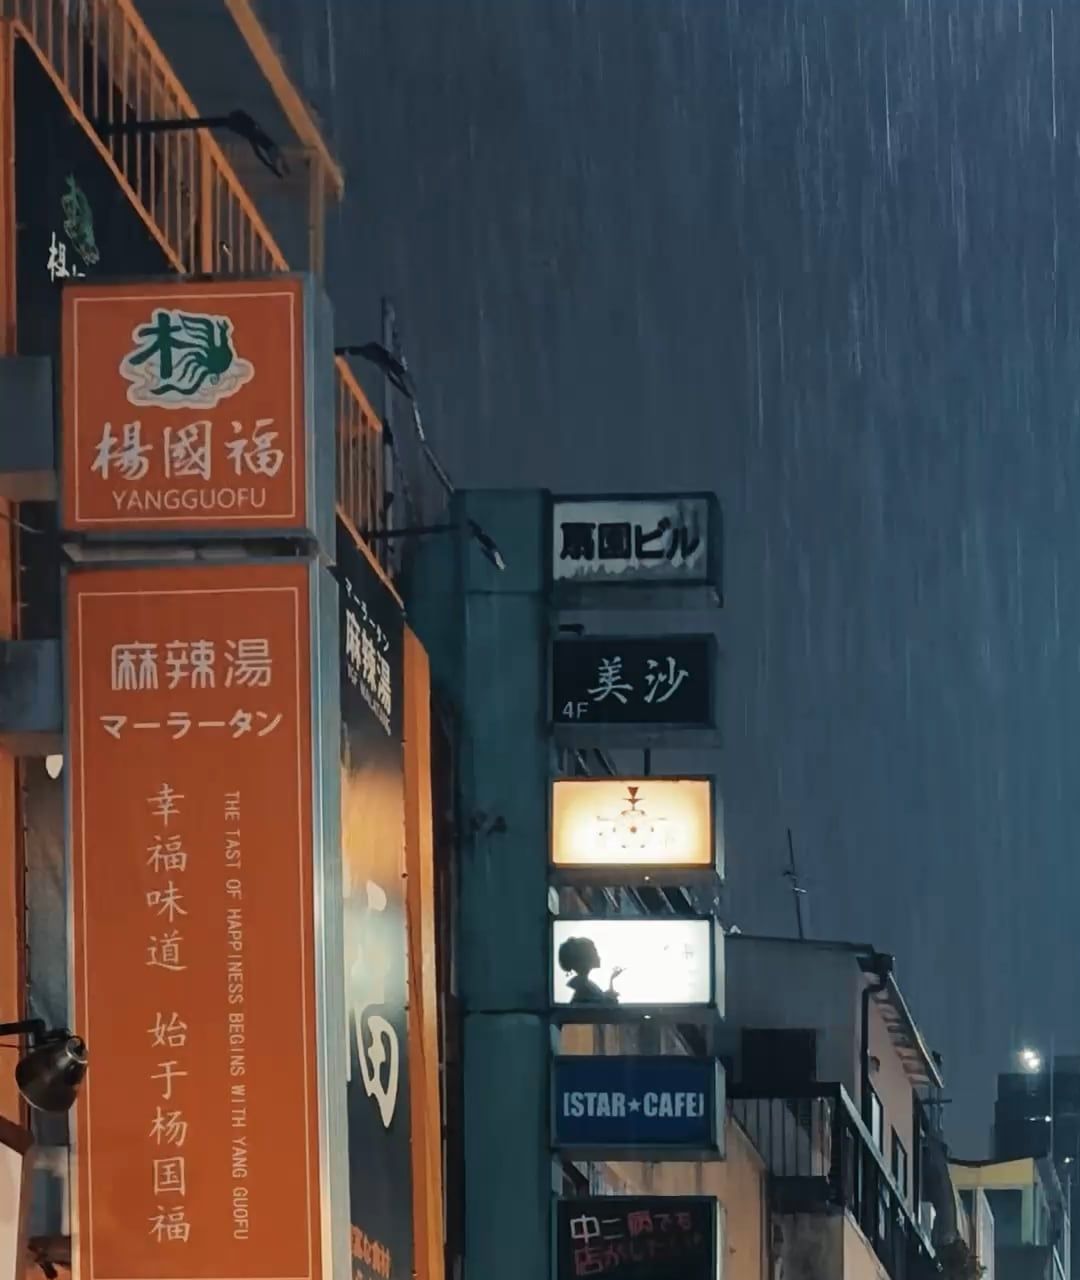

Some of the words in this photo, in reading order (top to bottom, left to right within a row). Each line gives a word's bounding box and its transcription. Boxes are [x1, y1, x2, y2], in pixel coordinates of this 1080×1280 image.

[90, 418, 286, 482] 楊國福
[112, 487, 267, 511] YANGGUOFU
[111, 638, 273, 690] 麻辣湯
[587, 656, 689, 704] 美沙
[100, 709, 283, 740] マーラータン
[562, 701, 589, 719] 4F
[224, 791, 241, 820] THE
[225, 829, 241, 869] TAST
[146, 782, 189, 972] 幸福味道
[225, 879, 242, 900] OF
[227, 908, 244, 1005] HAPPINESS
[229, 1013, 246, 1076] BEGINS
[147, 1012, 191, 1244] 始于杨国福
[231, 1085, 247, 1128] WITH
[232, 1136, 248, 1178] YANG
[233, 1187, 249, 1240] GUOFU
